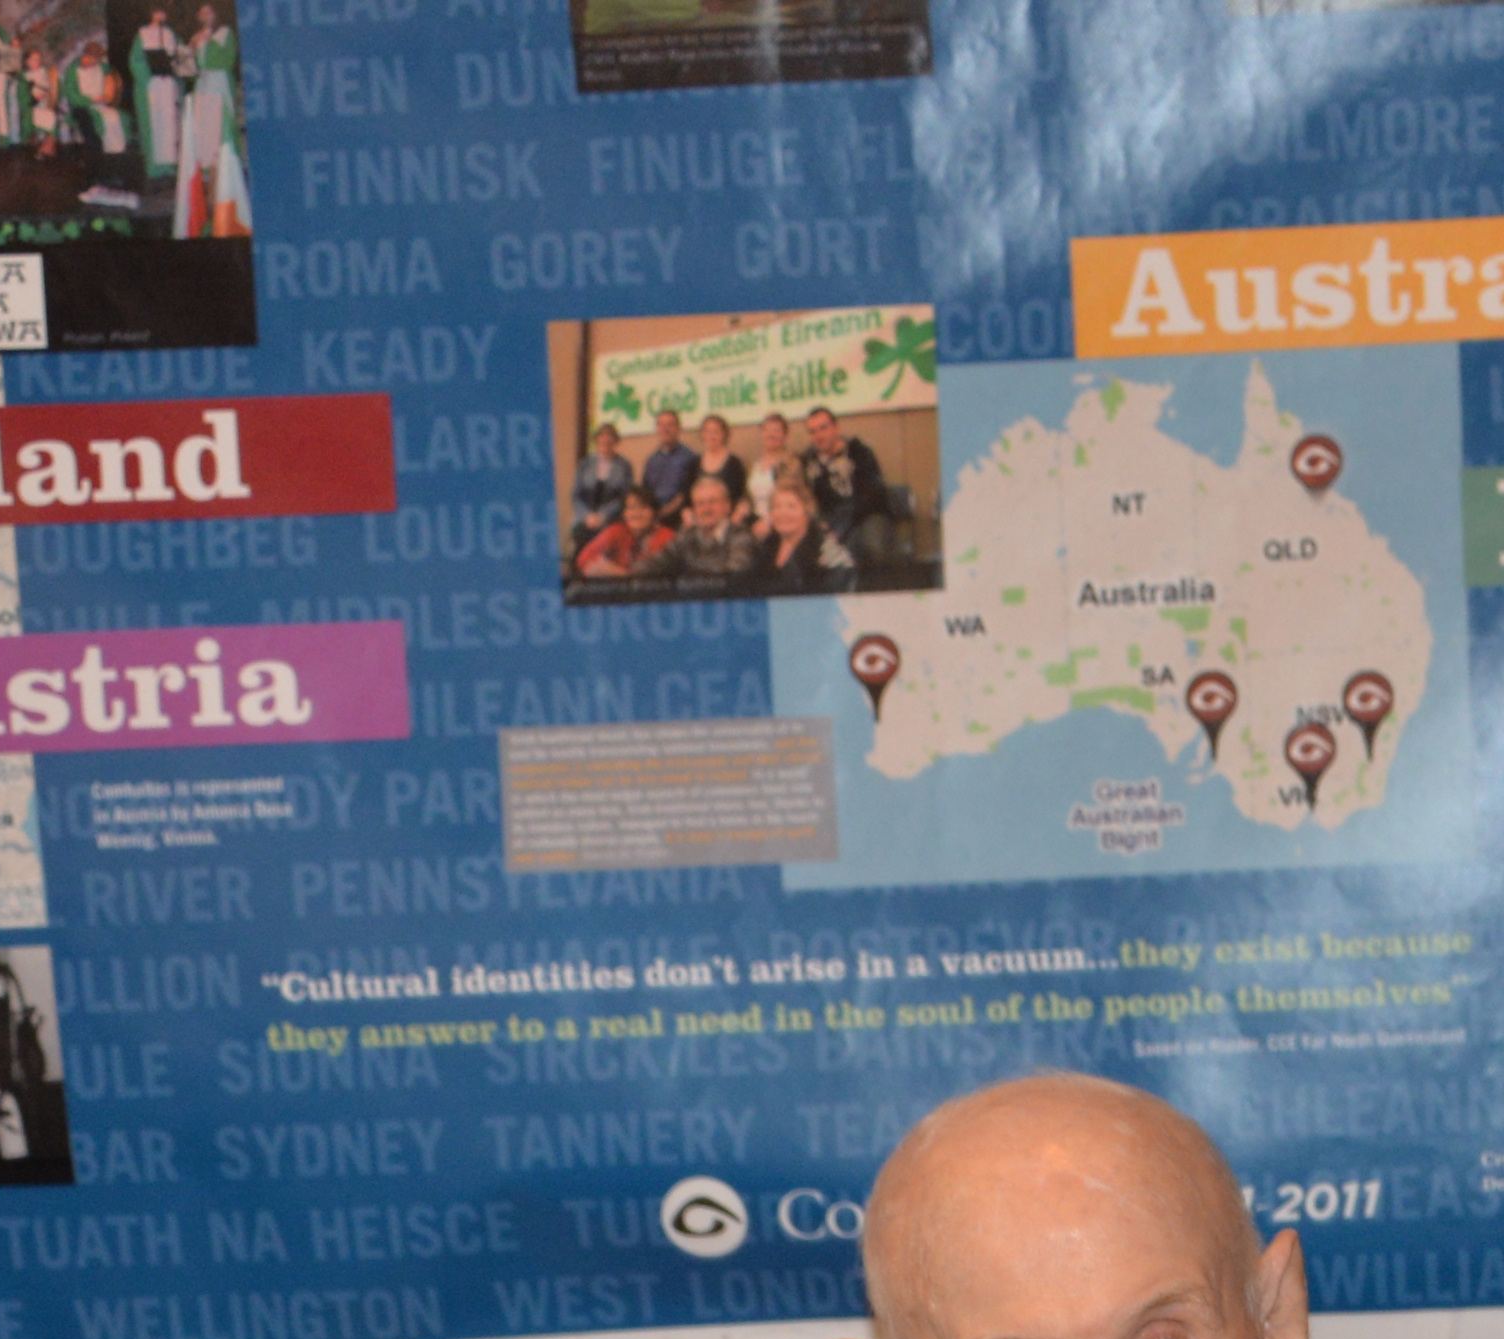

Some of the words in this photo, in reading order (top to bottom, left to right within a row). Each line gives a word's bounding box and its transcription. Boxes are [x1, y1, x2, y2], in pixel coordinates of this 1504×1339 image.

[300, 141, 543, 208] FINNISK
[496, 226, 684, 291] GOREY
[301, 323, 497, 388] KEADY
[1112, 493, 1145, 515] NT
[1263, 537, 1318, 561] QLD
[1077, 578, 1218, 608] Australia
[944, 614, 986, 637] WA
[1141, 665, 1175, 687] SA
[1069, 804, 1184, 828] Australian
[1095, 780, 1159, 801] Great
[1101, 827, 1161, 852] Bight
[83, 864, 254, 926] RIVER
[261, 966, 441, 1003] “Cultural
[451, 958, 636, 996] identities
[749, 951, 846, 983] arise
[856, 948, 896, 980] in
[906, 952, 930, 978] a
[1215, 933, 1312, 964] exist
[1321, 930, 1473, 959] because
[266, 1020, 348, 1055] they
[359, 1016, 498, 1048] answer
[507, 1012, 547, 1042] to
[555, 1014, 581, 1040] a
[589, 1006, 664, 1039] real
[675, 1002, 764, 1036] need
[775, 1003, 814, 1032] in
[824, 999, 886, 1029] the
[897, 995, 976, 1027] soul
[986, 992, 1025, 1023] of
[1032, 990, 1095, 1021] the
[1103, 984, 1227, 1026] people
[216, 1120, 445, 1180] SYDNEY
[482, 1106, 756, 1171] TANNERY
[208, 1208, 289, 1264] NA
[310, 1202, 520, 1262] HEISCE
[495, 1271, 661, 1331] WEST
